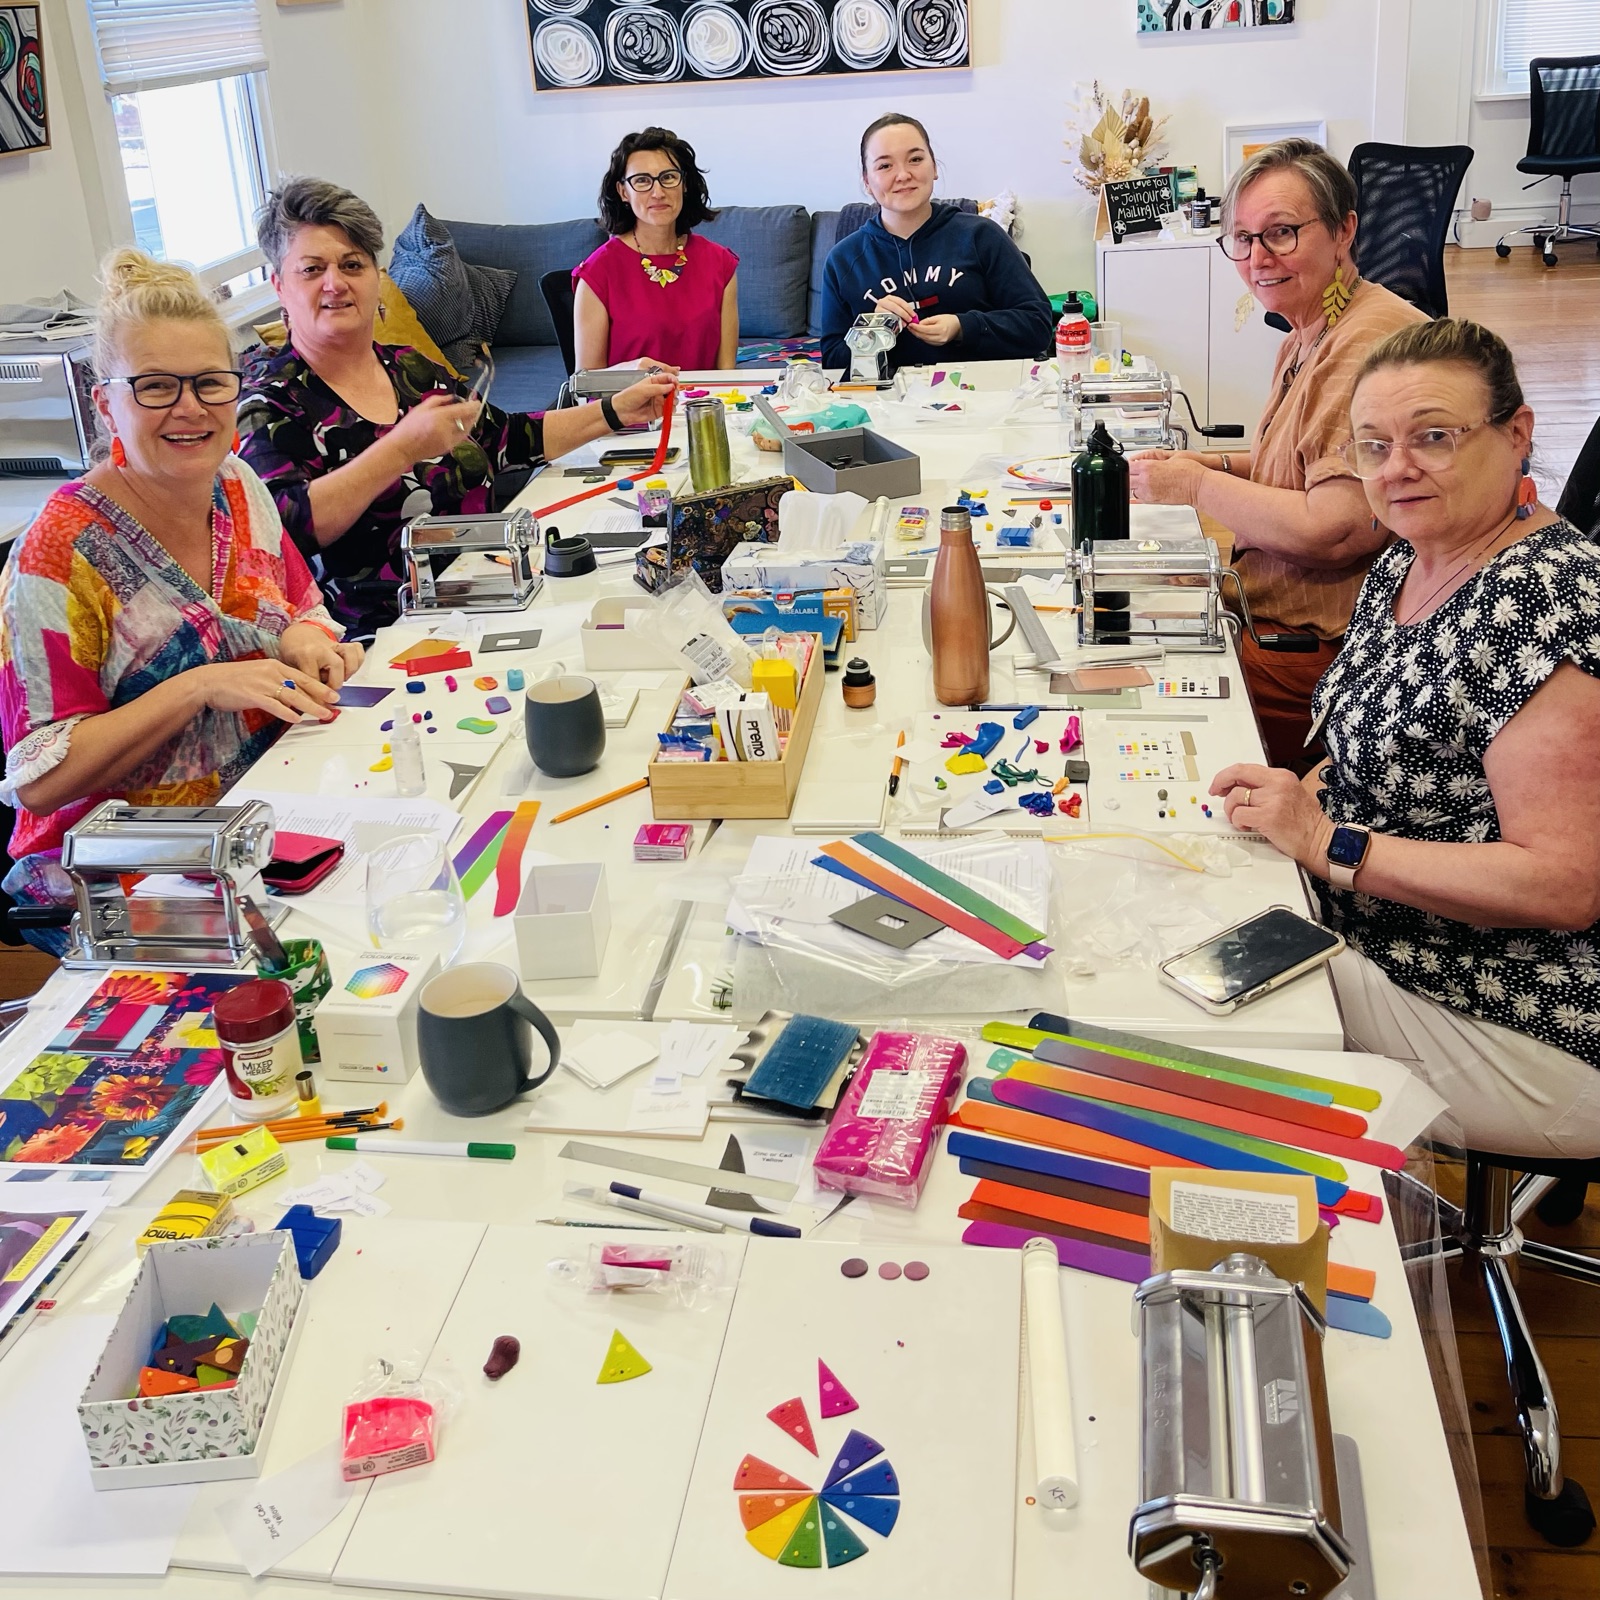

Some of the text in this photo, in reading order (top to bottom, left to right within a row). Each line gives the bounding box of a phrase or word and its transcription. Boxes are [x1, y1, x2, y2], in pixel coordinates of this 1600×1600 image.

[1110, 194, 1120, 203] to
[1121, 192, 1142, 206] Join
[863, 265, 965, 304] TOMMY
[242, 1060, 273, 1070] MIXED
[245, 1066, 272, 1076] HERBS
[269, 1504, 284, 1526] Yellow
[268, 1524, 280, 1540] Zinc
